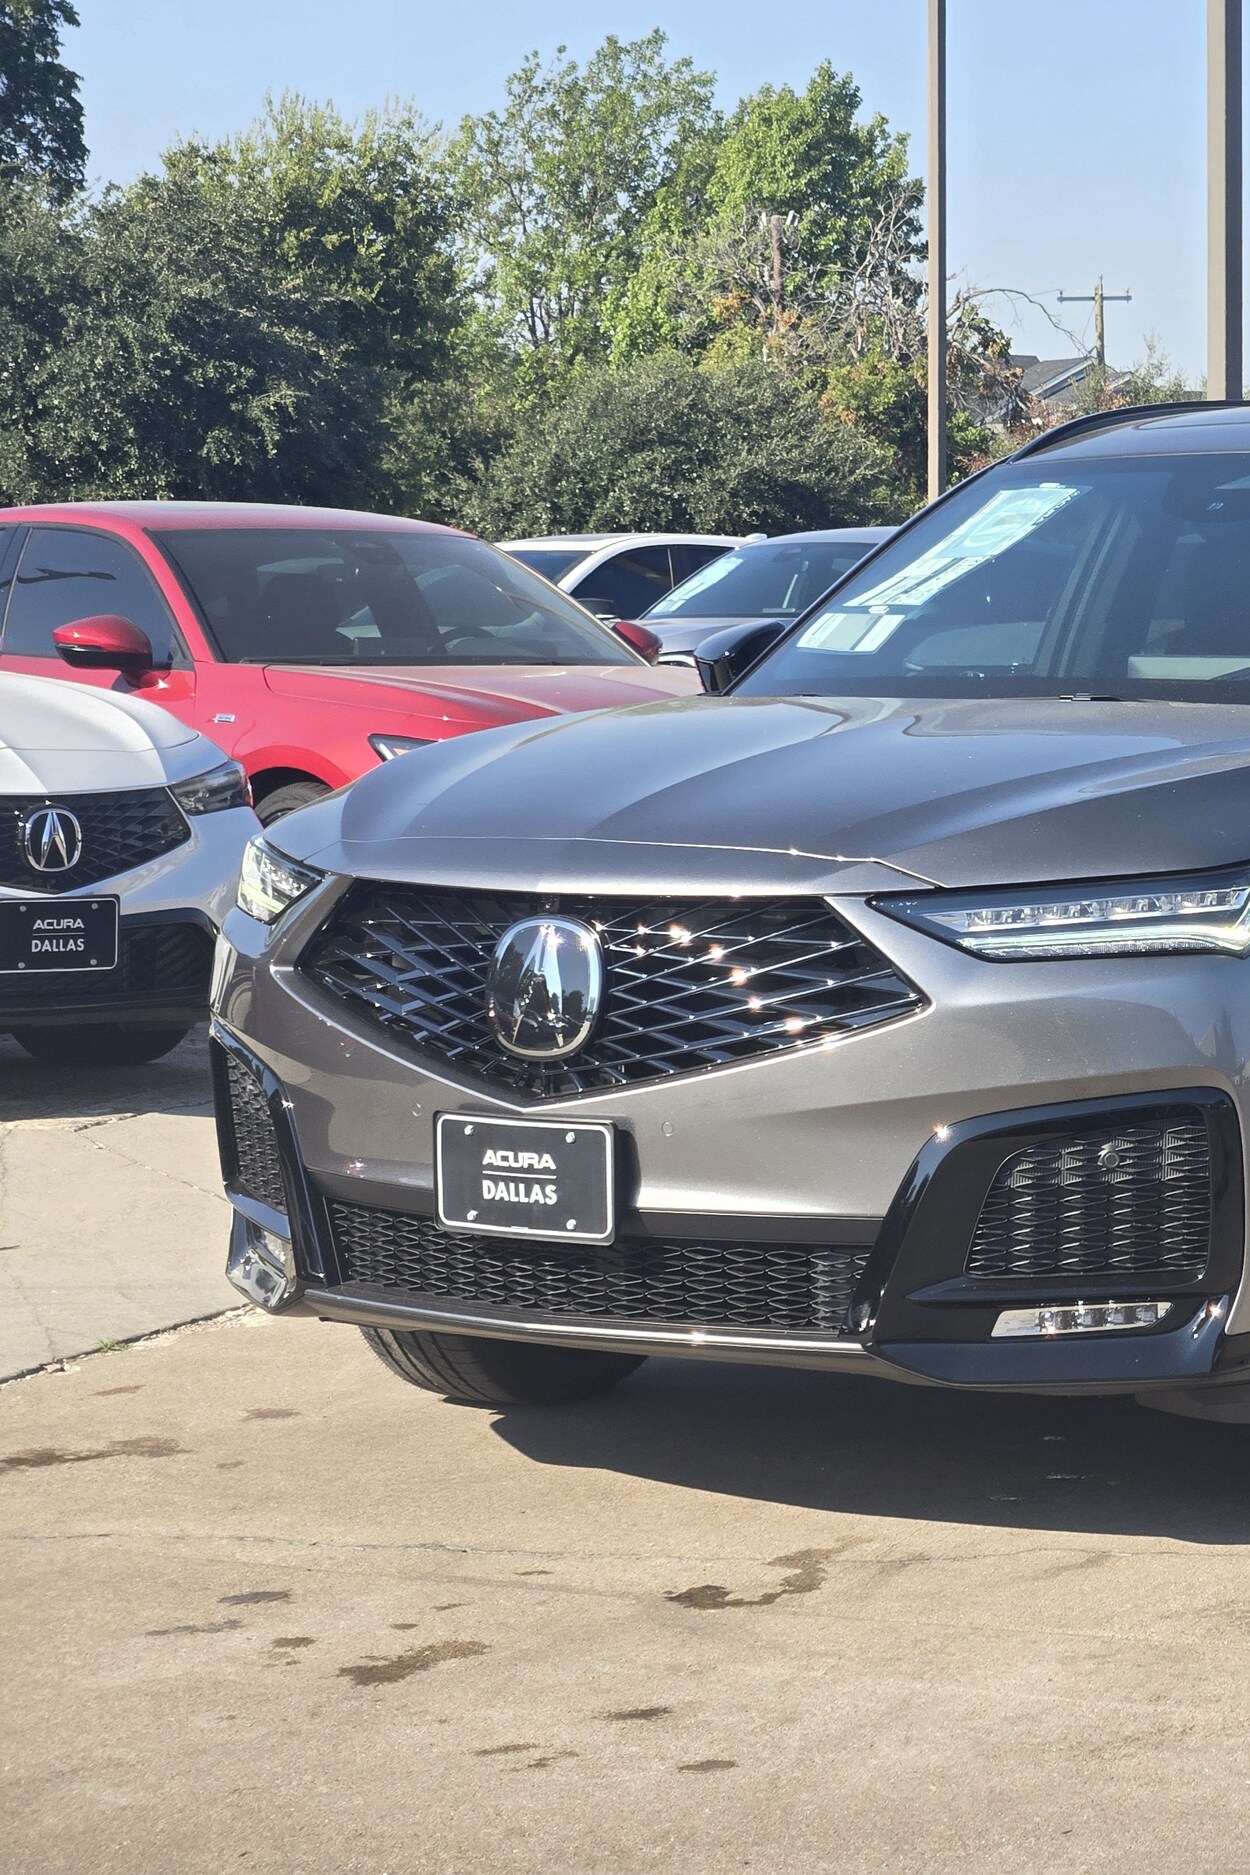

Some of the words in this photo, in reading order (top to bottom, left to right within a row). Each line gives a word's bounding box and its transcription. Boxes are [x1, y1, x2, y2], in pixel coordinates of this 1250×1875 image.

[32, 919, 85, 930] ACURA
[31, 938, 85, 952] DALLAS
[482, 1149, 557, 1170] ACURA
[482, 1179, 558, 1205] DALLAS
